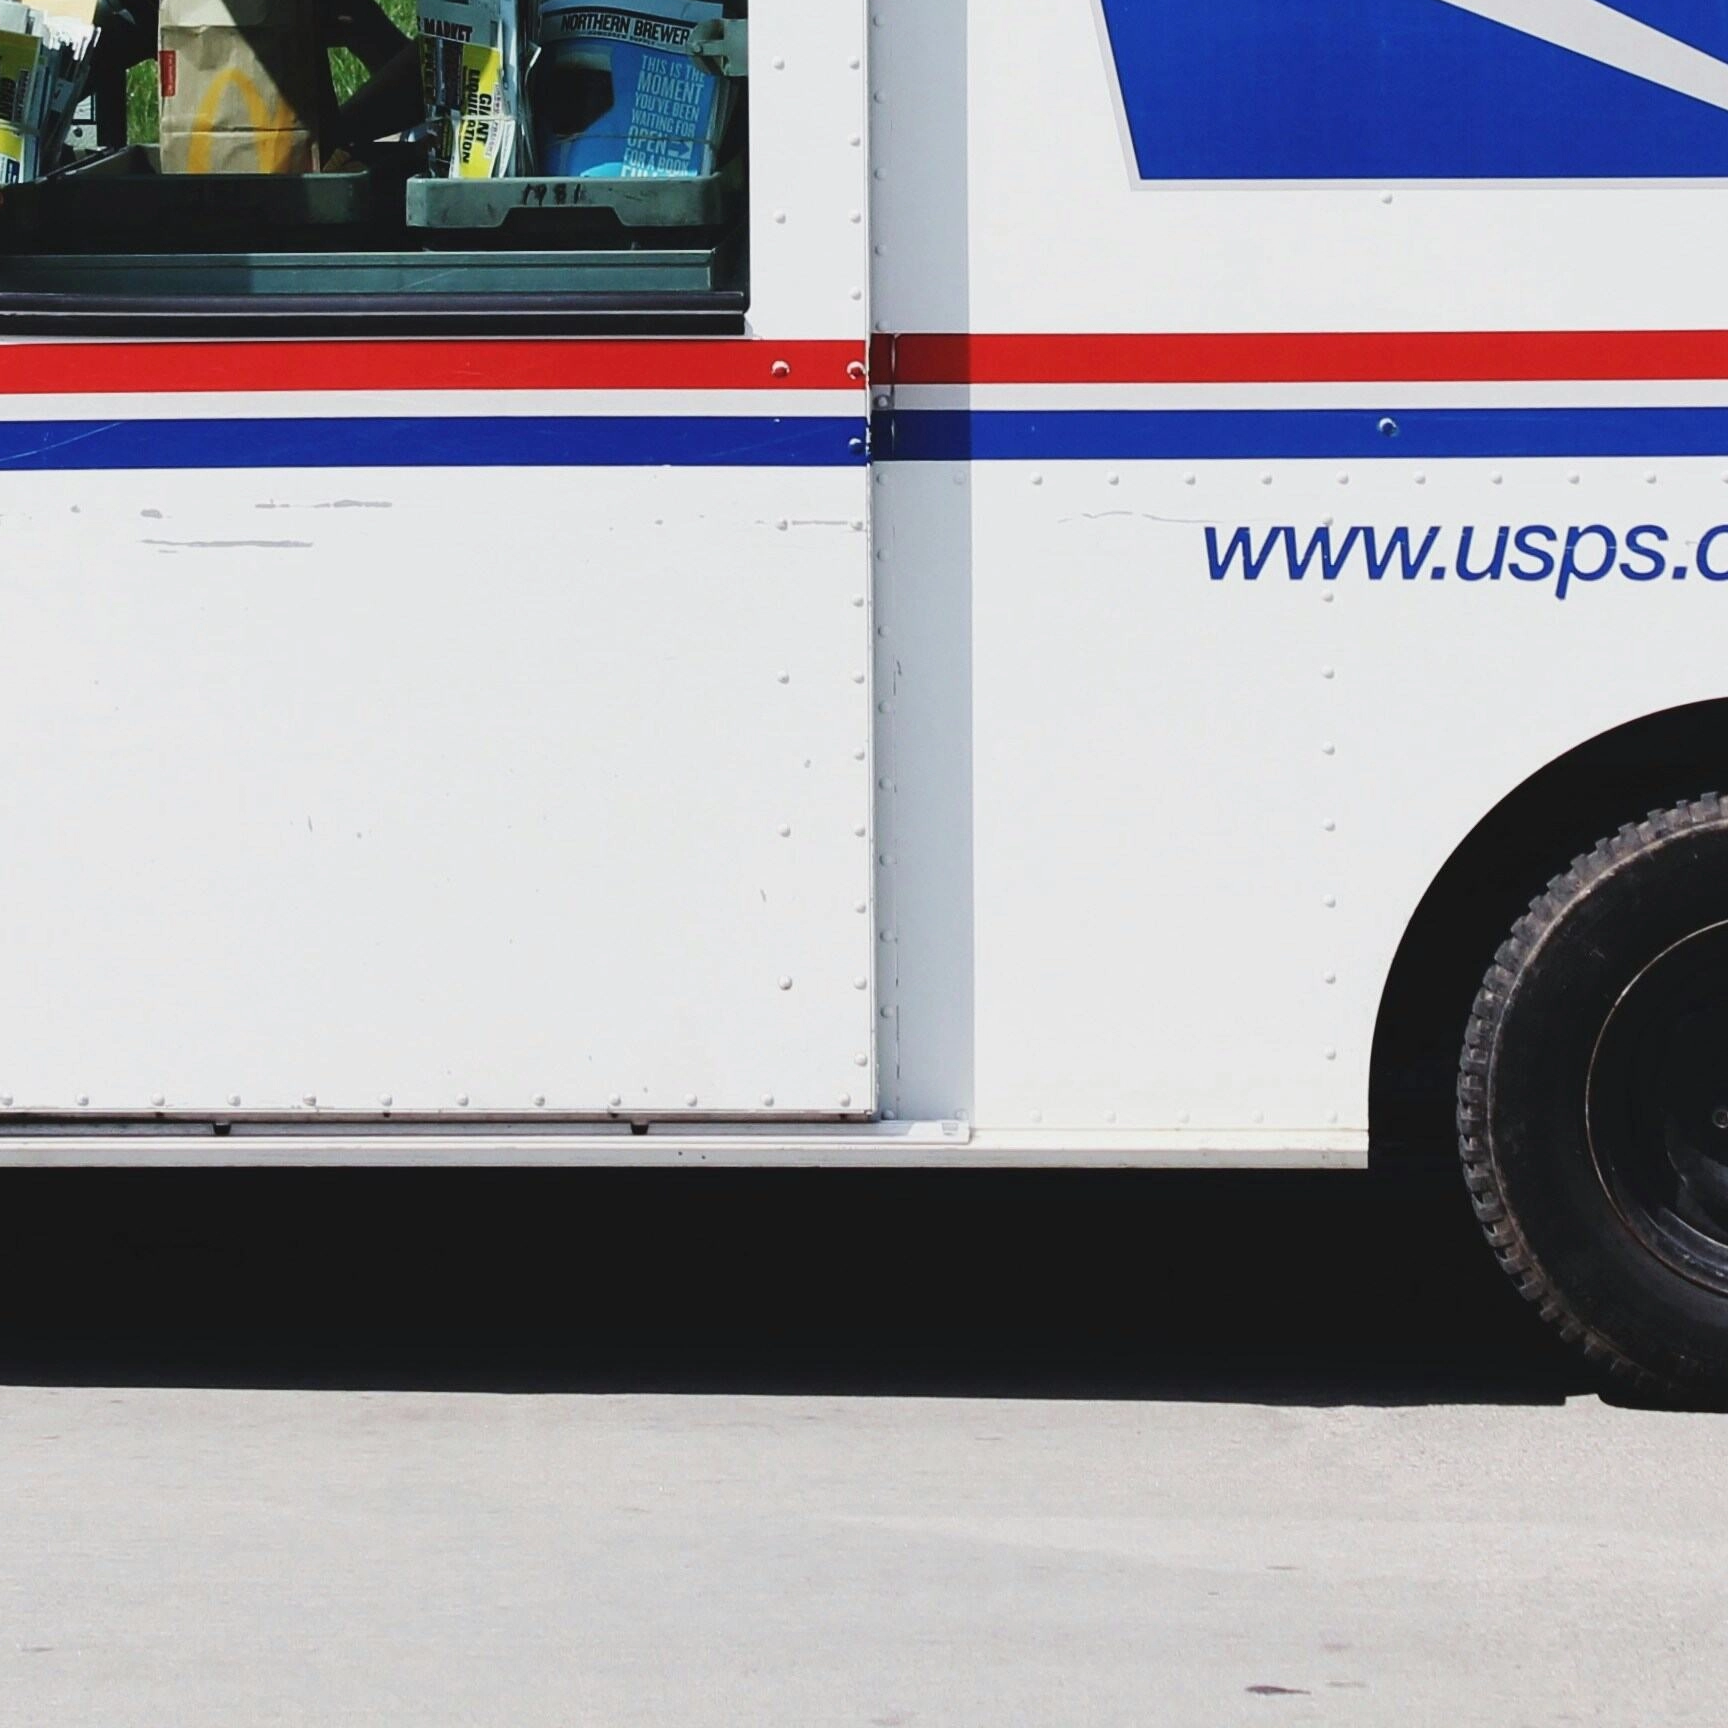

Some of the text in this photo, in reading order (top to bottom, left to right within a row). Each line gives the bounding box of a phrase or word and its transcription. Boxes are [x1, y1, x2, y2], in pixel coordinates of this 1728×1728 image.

[561, 13, 690, 45] NORTHERN BREWER
[641, 55, 705, 83] THIS IS THE
[637, 71, 705, 105] MOMENT
[635, 91, 700, 121] YOU'VE BEEN
[631, 109, 696, 139] WAITING FOR
[627, 126, 668, 155] OPEN
[623, 148, 646, 168] FOR
[657, 157, 689, 176] BOOK
